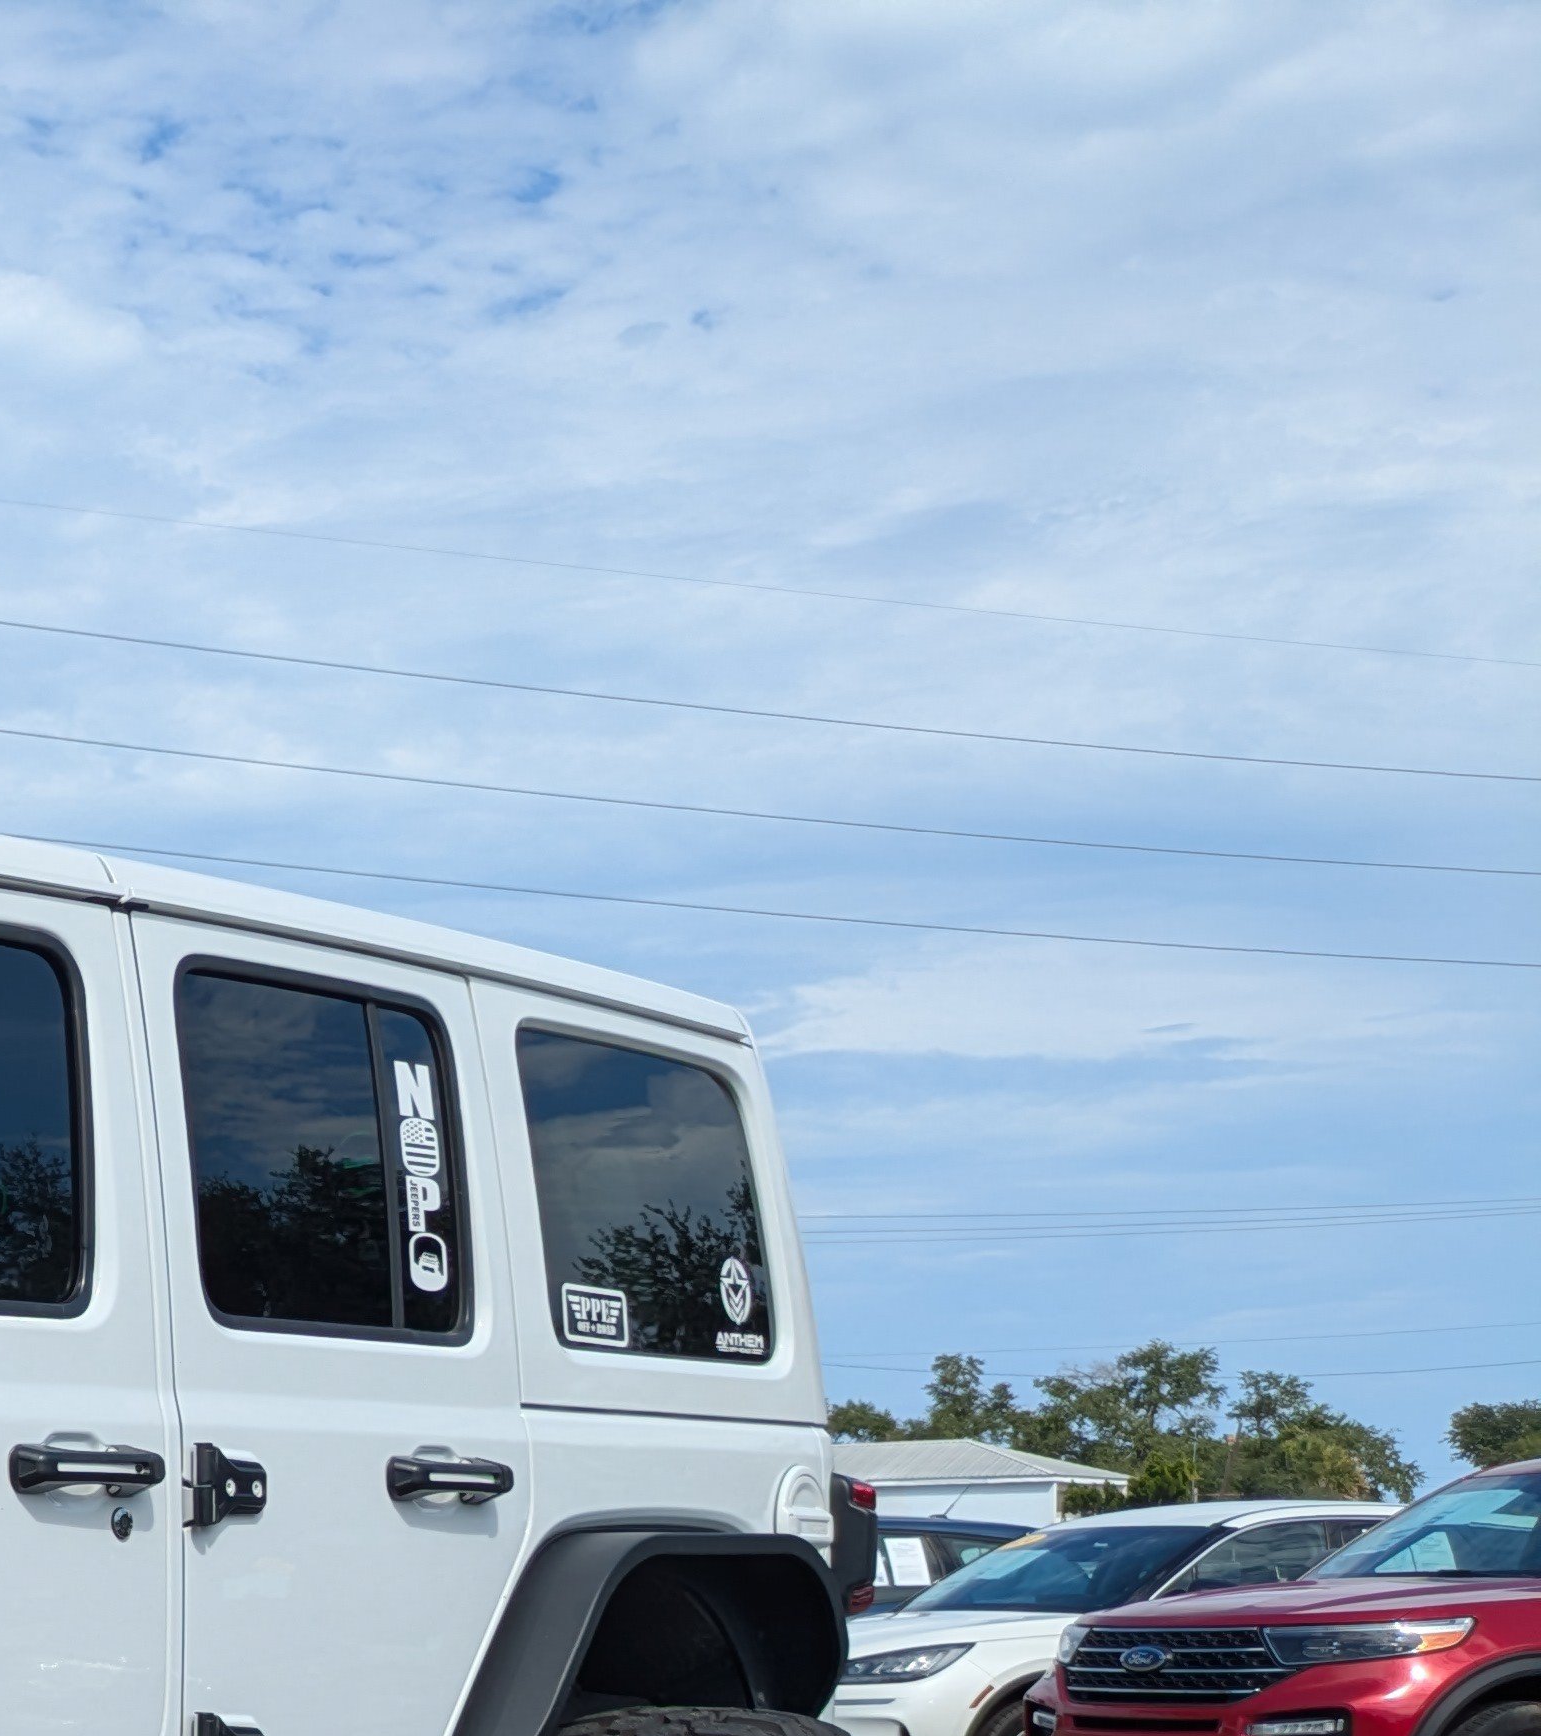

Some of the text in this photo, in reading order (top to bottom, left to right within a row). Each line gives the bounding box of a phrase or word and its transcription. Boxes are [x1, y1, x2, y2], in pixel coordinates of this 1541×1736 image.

[410, 1179, 421, 1227] JEEPERS
[576, 1295, 616, 1324] PPE
[715, 1331, 764, 1348] ANTHEM
